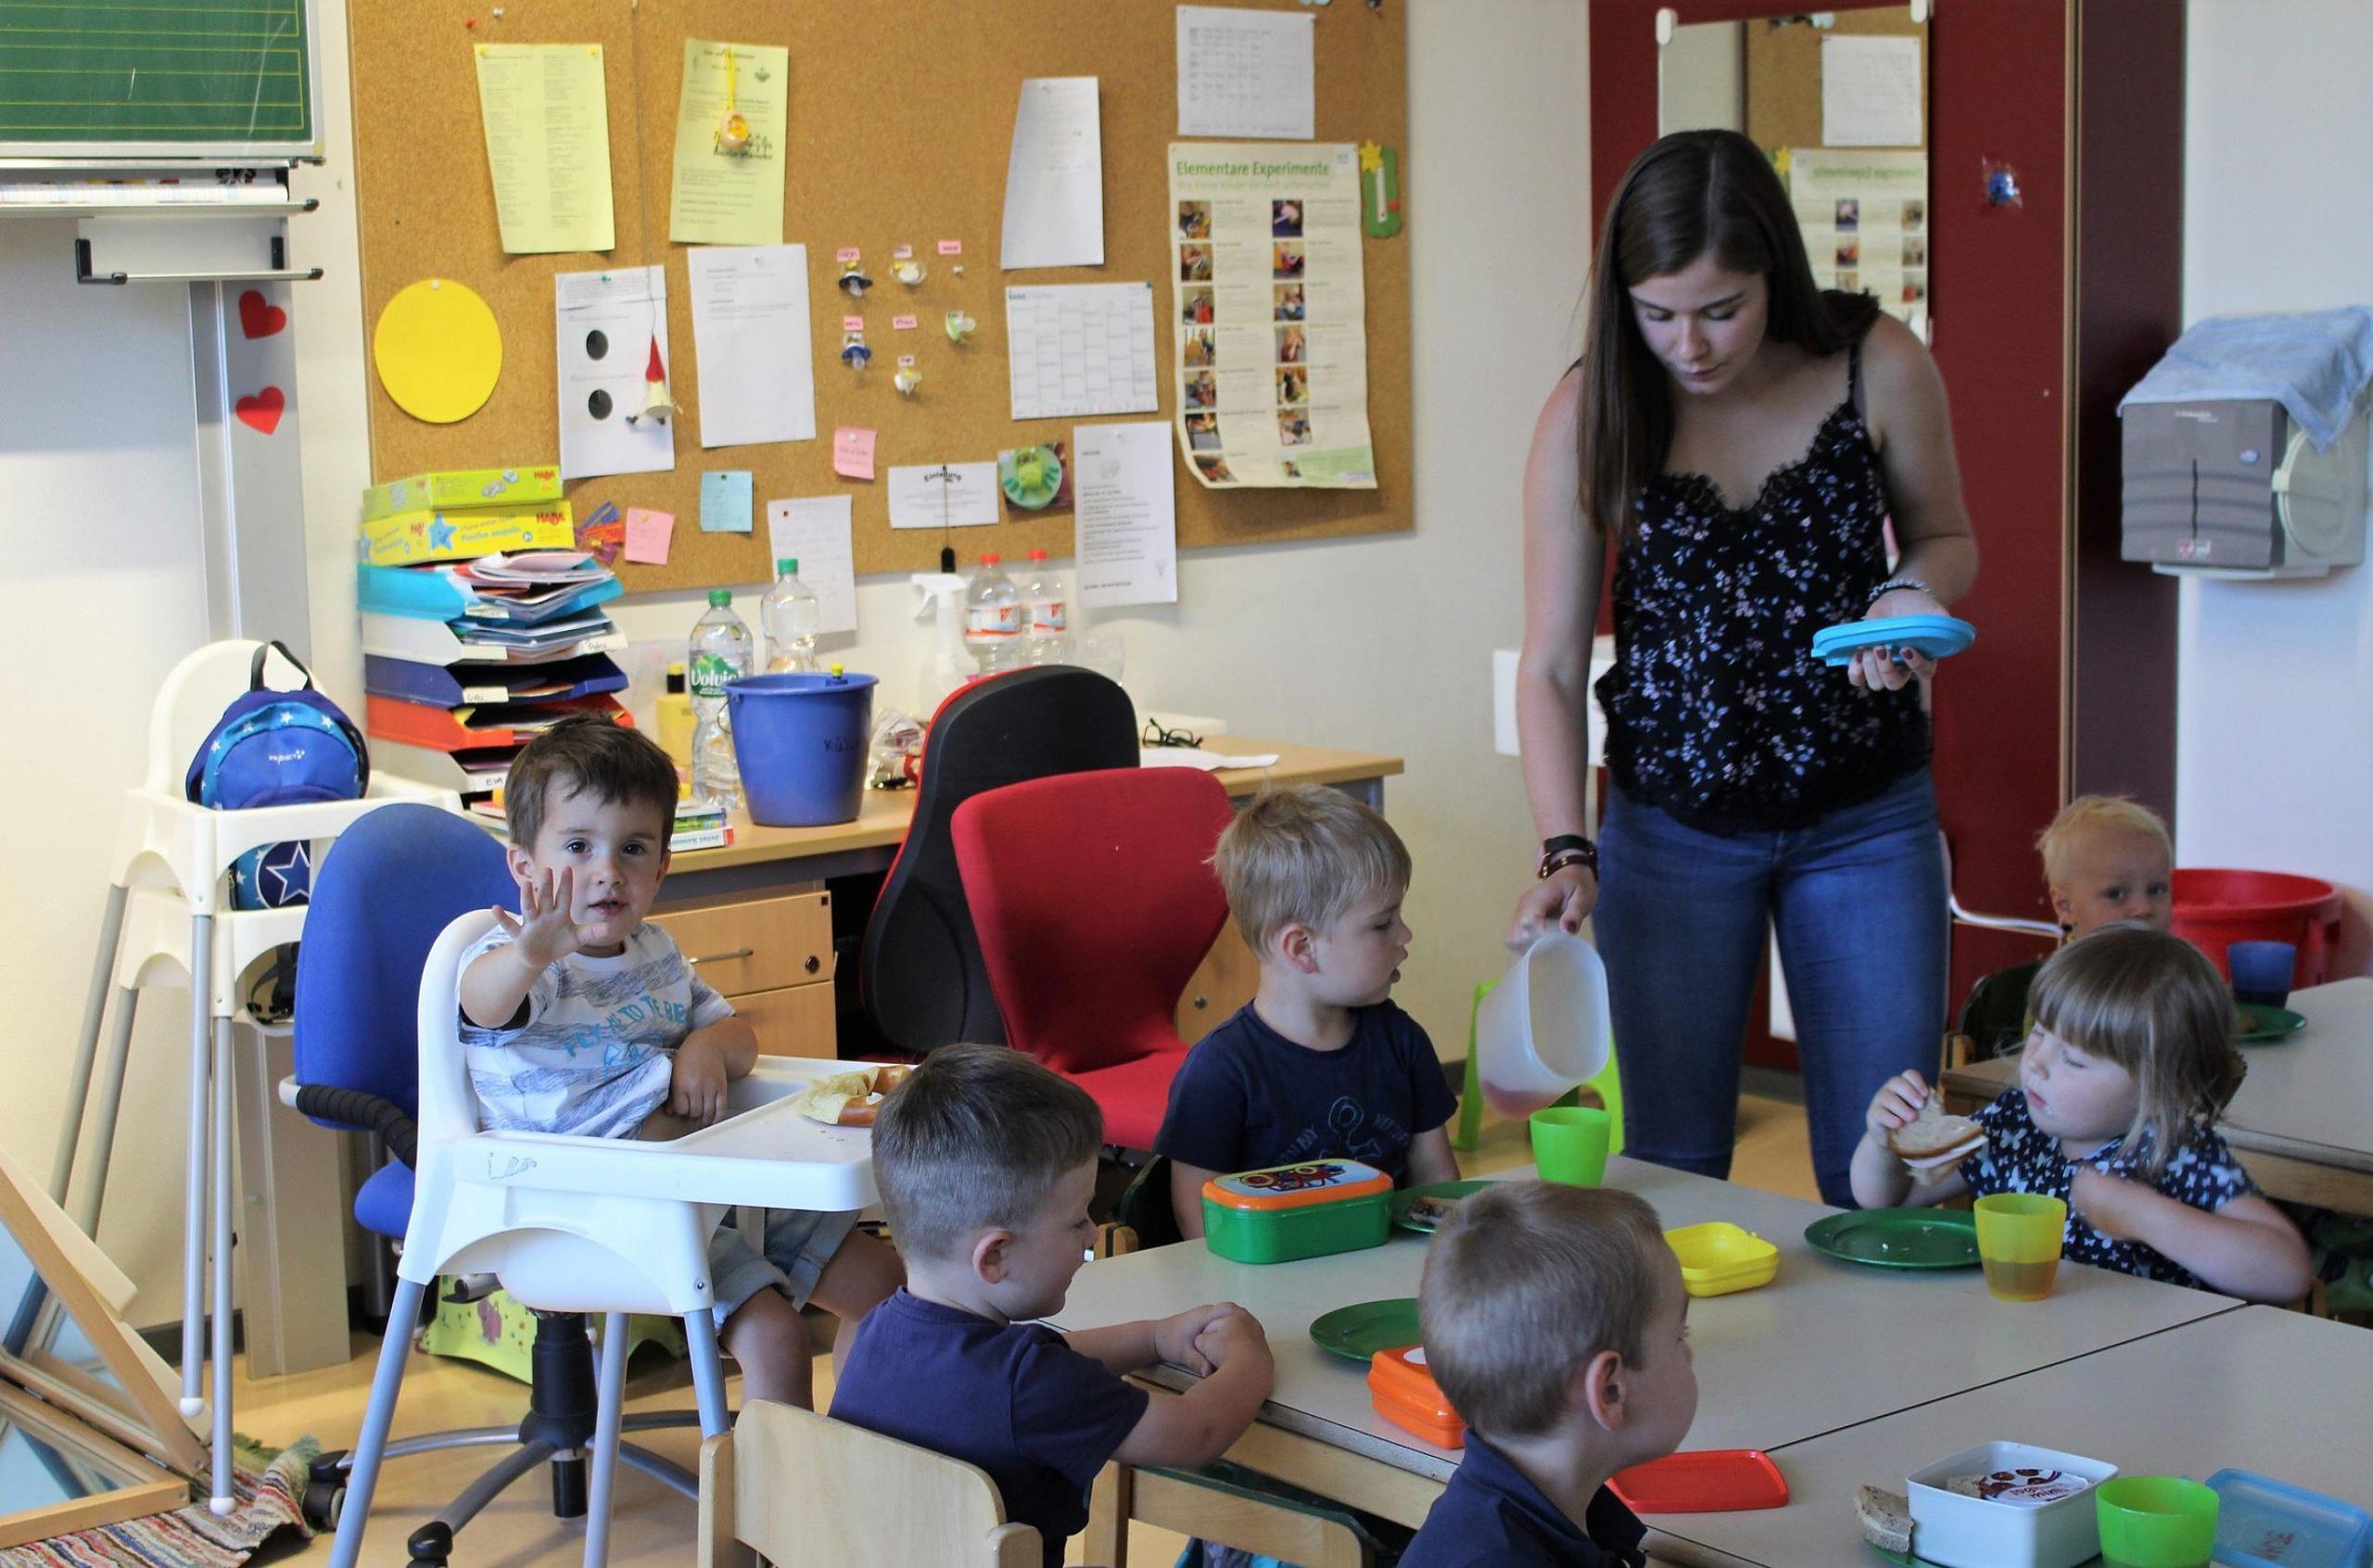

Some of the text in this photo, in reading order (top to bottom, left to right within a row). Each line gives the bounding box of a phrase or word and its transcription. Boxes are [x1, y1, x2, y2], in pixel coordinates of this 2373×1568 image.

[1176, 161, 1330, 178] Elementare Experimente
[536, 512, 565, 525] HABA
[617, 1004, 645, 1022] TO
